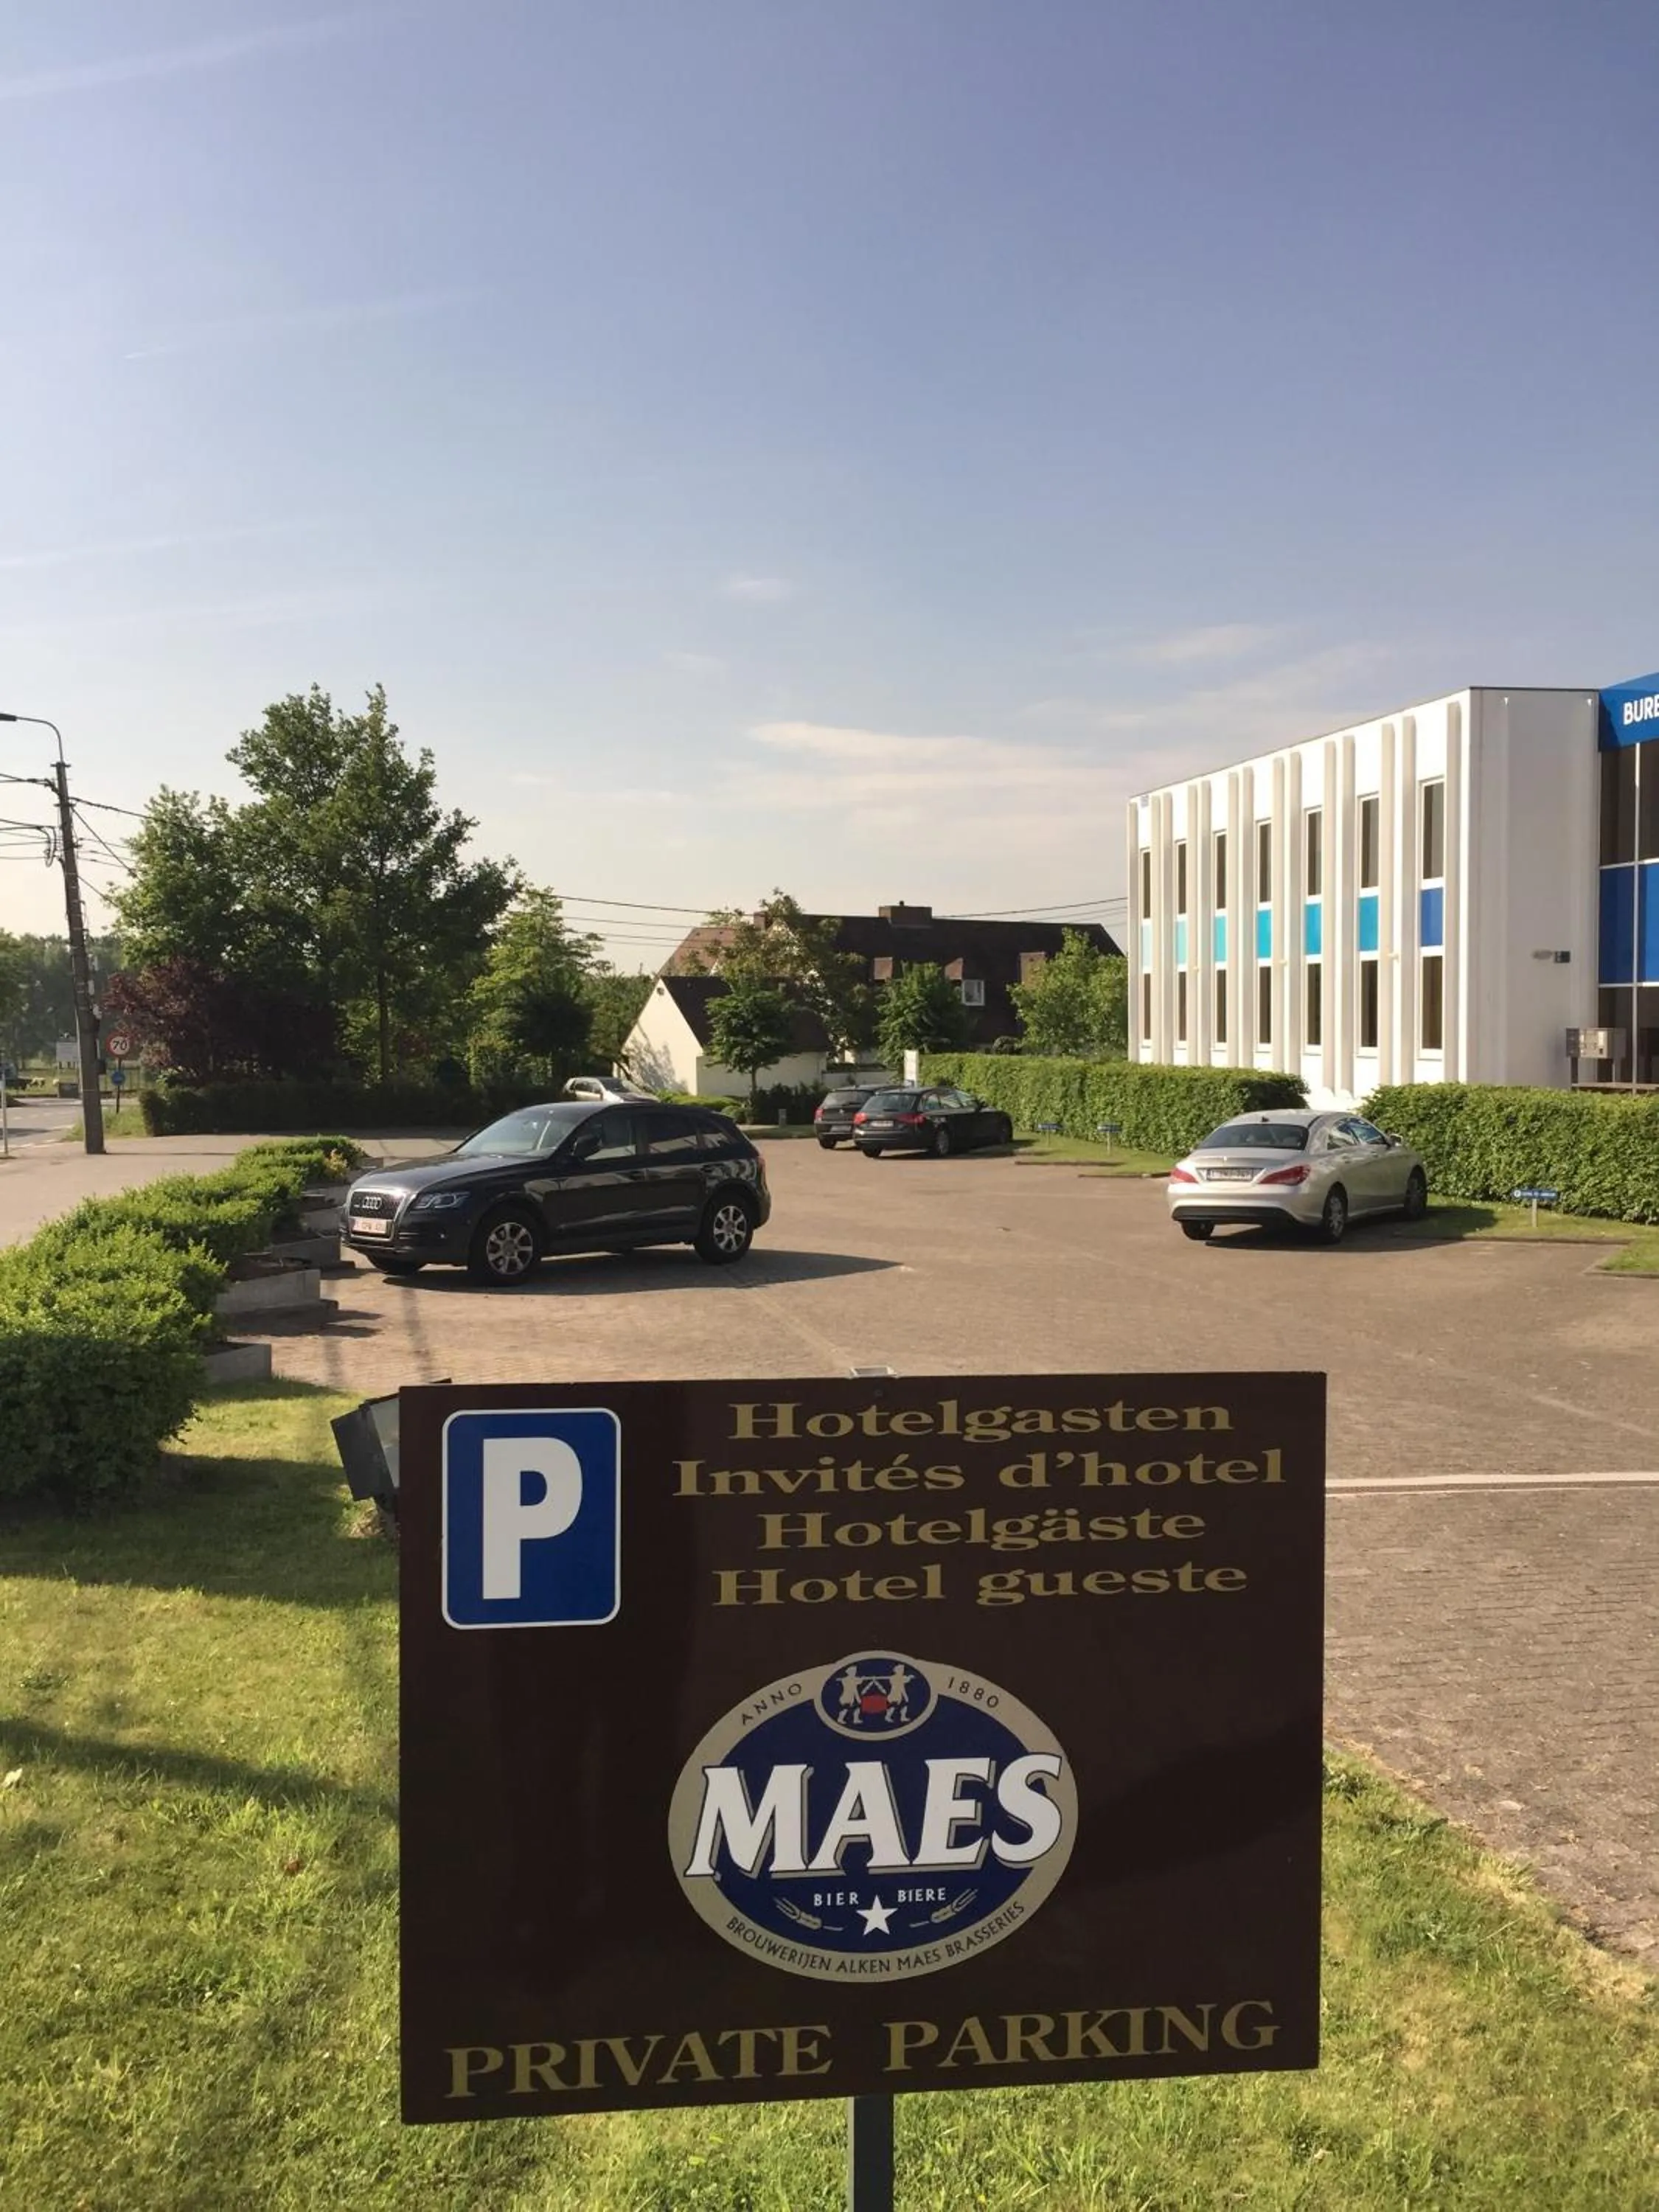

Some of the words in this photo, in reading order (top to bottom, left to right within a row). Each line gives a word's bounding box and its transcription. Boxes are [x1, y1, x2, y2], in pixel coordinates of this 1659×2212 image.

[113, 1040, 128, 1051] 70
[728, 1400, 1234, 1443] Hotelgasten
[672, 1454, 965, 1497] Invités
[483, 1437, 582, 1599] P
[757, 1509, 1206, 1551] Hotelgäste
[712, 1564, 945, 1606] Hotel
[976, 1562, 1248, 1605] gueste
[741, 1683, 802, 1725] ANNO
[947, 1676, 1001, 1709] 1880
[684, 1752, 1062, 1877] MAES
[813, 1891, 859, 1907] BIER
[897, 1887, 946, 1902] BIERE
[726, 1916, 831, 1971] BROUWERIJEN
[835, 1958, 890, 1974] ALKEN
[897, 1948, 942, 1971] MAES
[945, 1901, 1025, 1957] BRASSERIES
[444, 2024, 832, 2098] PRIVATE
[883, 2000, 1281, 2071] PARKING
